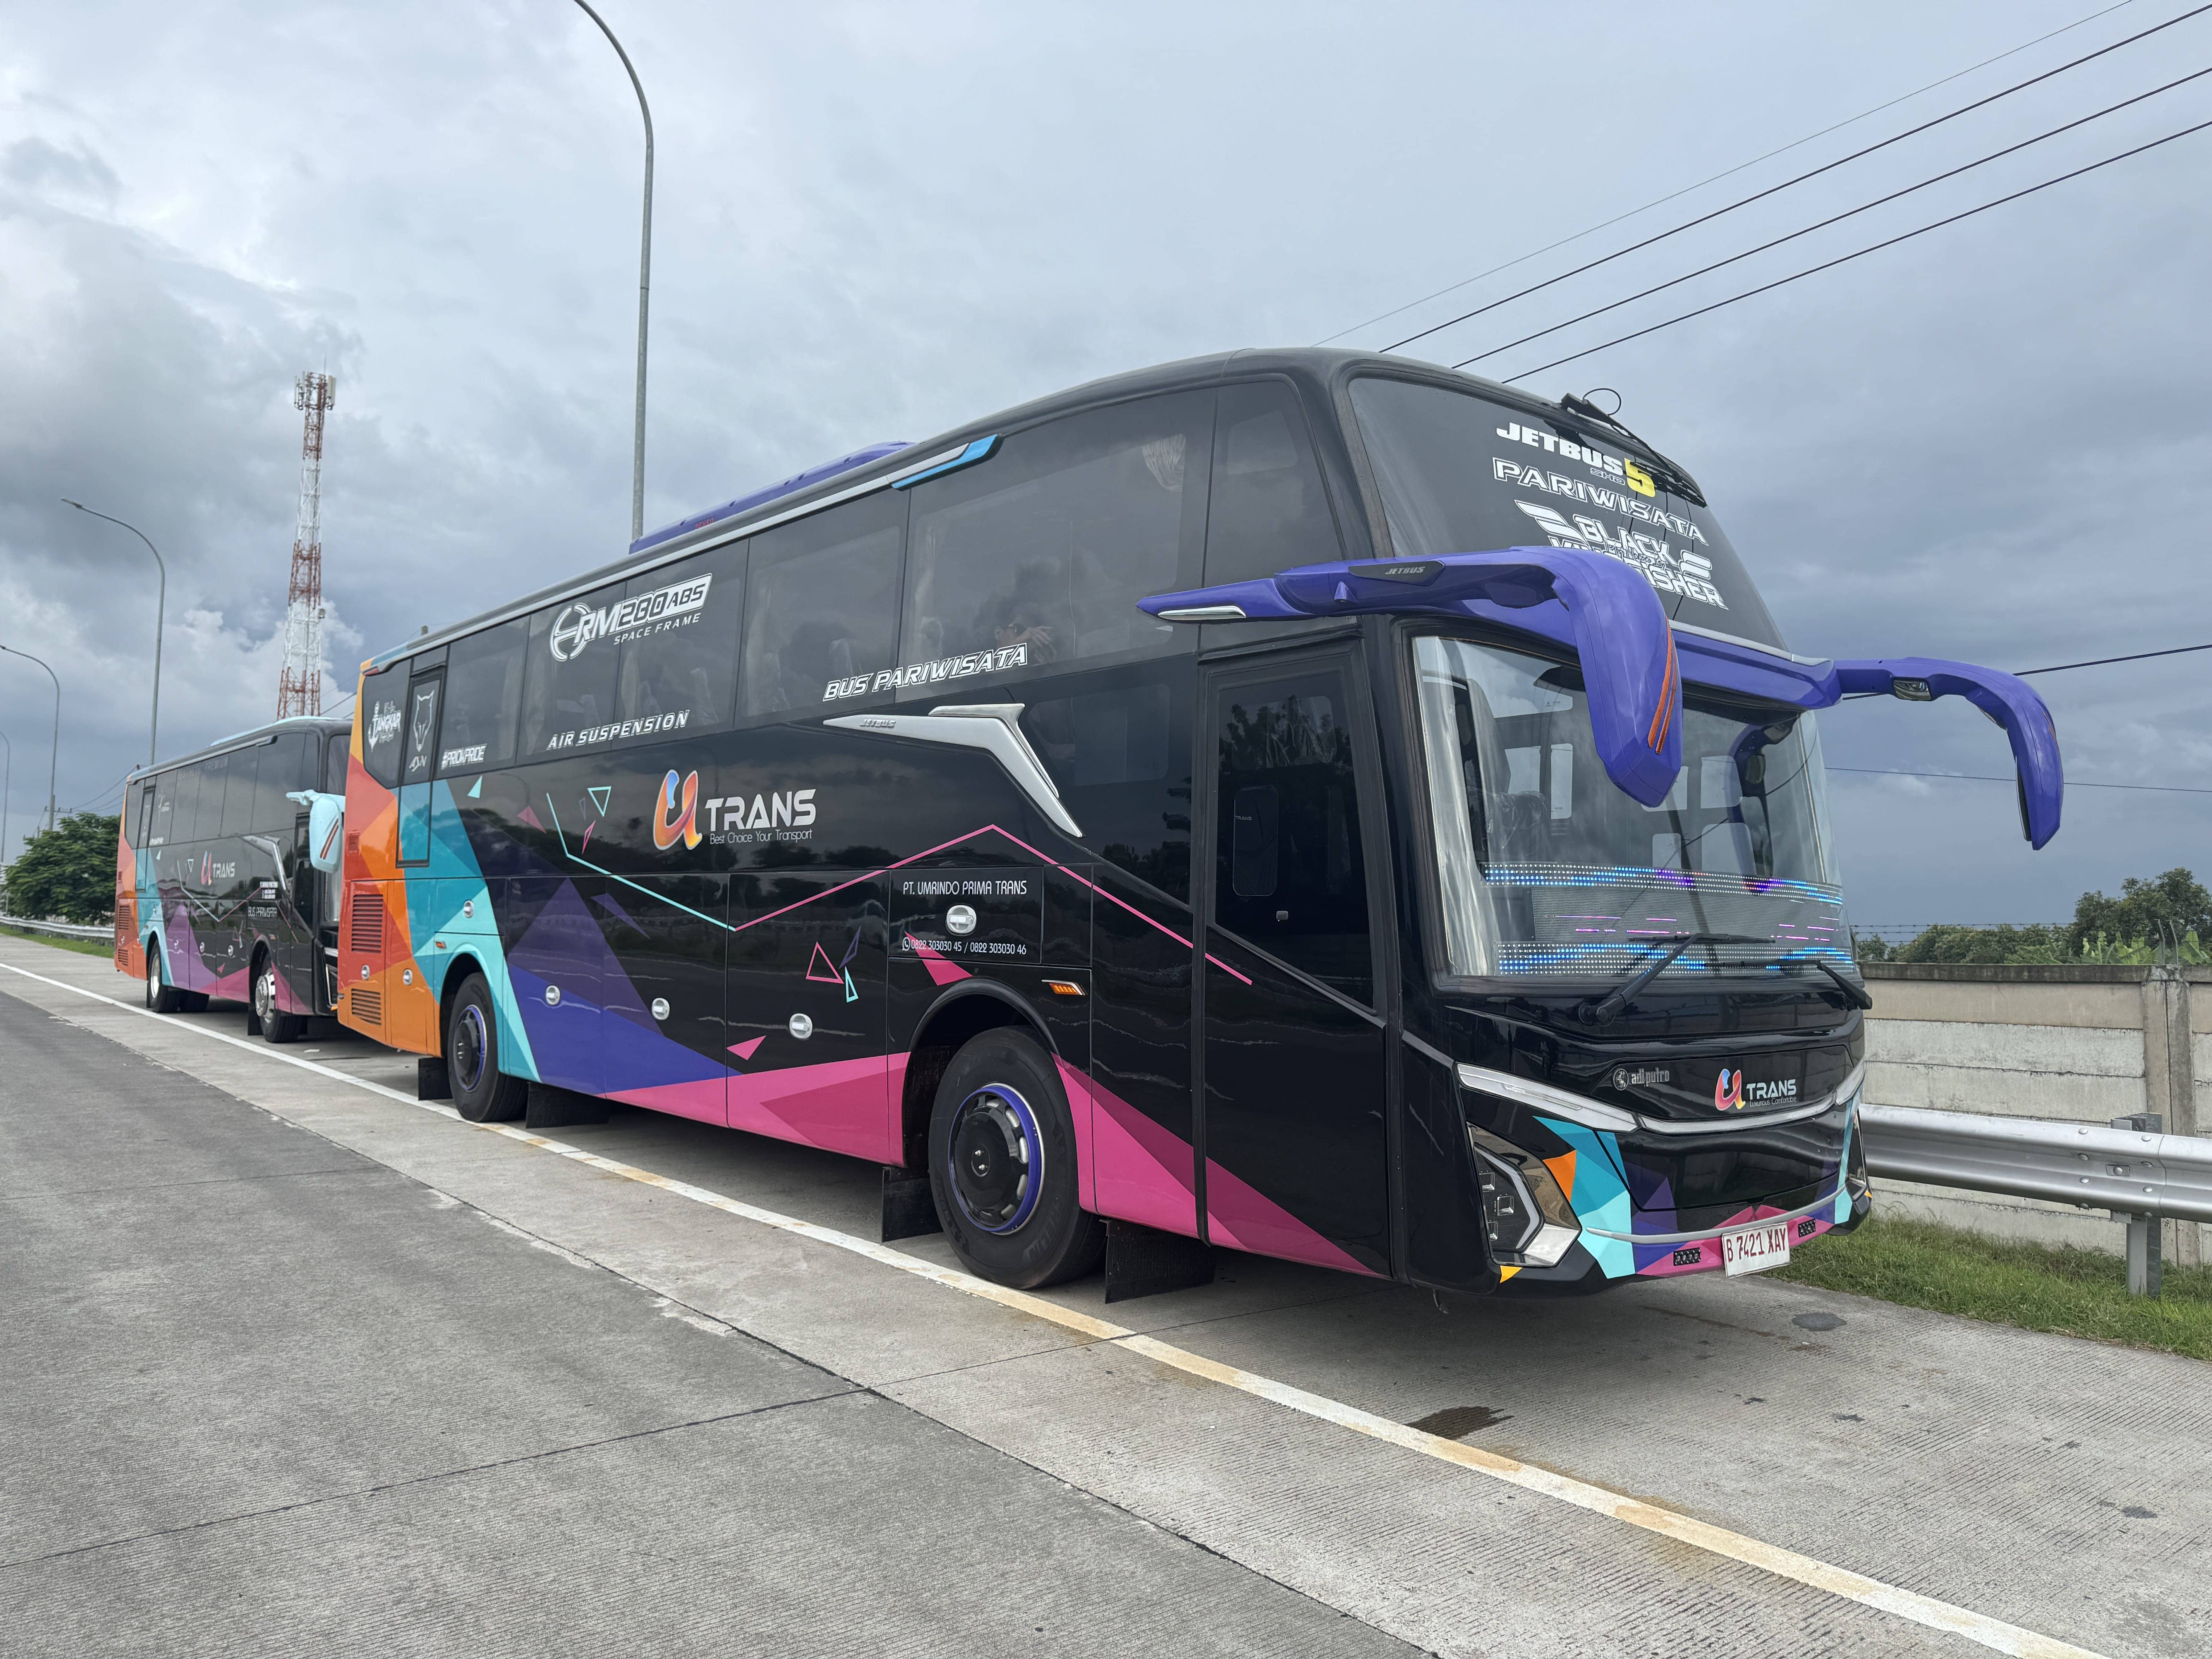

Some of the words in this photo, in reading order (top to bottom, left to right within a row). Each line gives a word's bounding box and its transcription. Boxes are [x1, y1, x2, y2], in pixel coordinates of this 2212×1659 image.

[1496, 422, 1624, 476] JETBUS
[1624, 457, 1656, 498] 5
[1590, 467, 1625, 486] SHD
[1492, 457, 1709, 546] PARIWISATA
[1572, 514, 1678, 567] BLACK
[1385, 566, 1425, 575] JETBUS
[613, 626, 653, 645] SPACE
[655, 613, 701, 633] FRAME
[822, 673, 874, 702] BUS
[871, 642, 1027, 693] PARIWISATA
[546, 730, 575, 751] AIR
[575, 710, 690, 746] SUSPENSION
[705, 789, 816, 832] TRANS
[710, 833, 725, 845] Best
[727, 832, 753, 843] Choice
[756, 831, 772, 842] Your
[775, 828, 812, 843] Transport
[212, 862, 235, 878] TRANS
[903, 881, 915, 895] PT.
[917, 881, 960, 895] UMRINDO
[962, 881, 992, 895] PRIMA
[995, 880, 1027, 895] TRANS
[911, 939, 927, 950] 0822
[928, 940, 952, 951] 303030
[953, 941, 962, 951] 45
[970, 942, 988, 953] 0822
[989, 943, 1015, 954] 303030
[1017, 944, 1027, 955] 46
[1631, 1067, 1670, 1087] adiputro
[1746, 1079, 1797, 1100] TRANS
[1726, 1238, 1734, 1262] B
[1736, 1231, 1765, 1260] 7421
[1767, 1228, 1786, 1254] XAY
